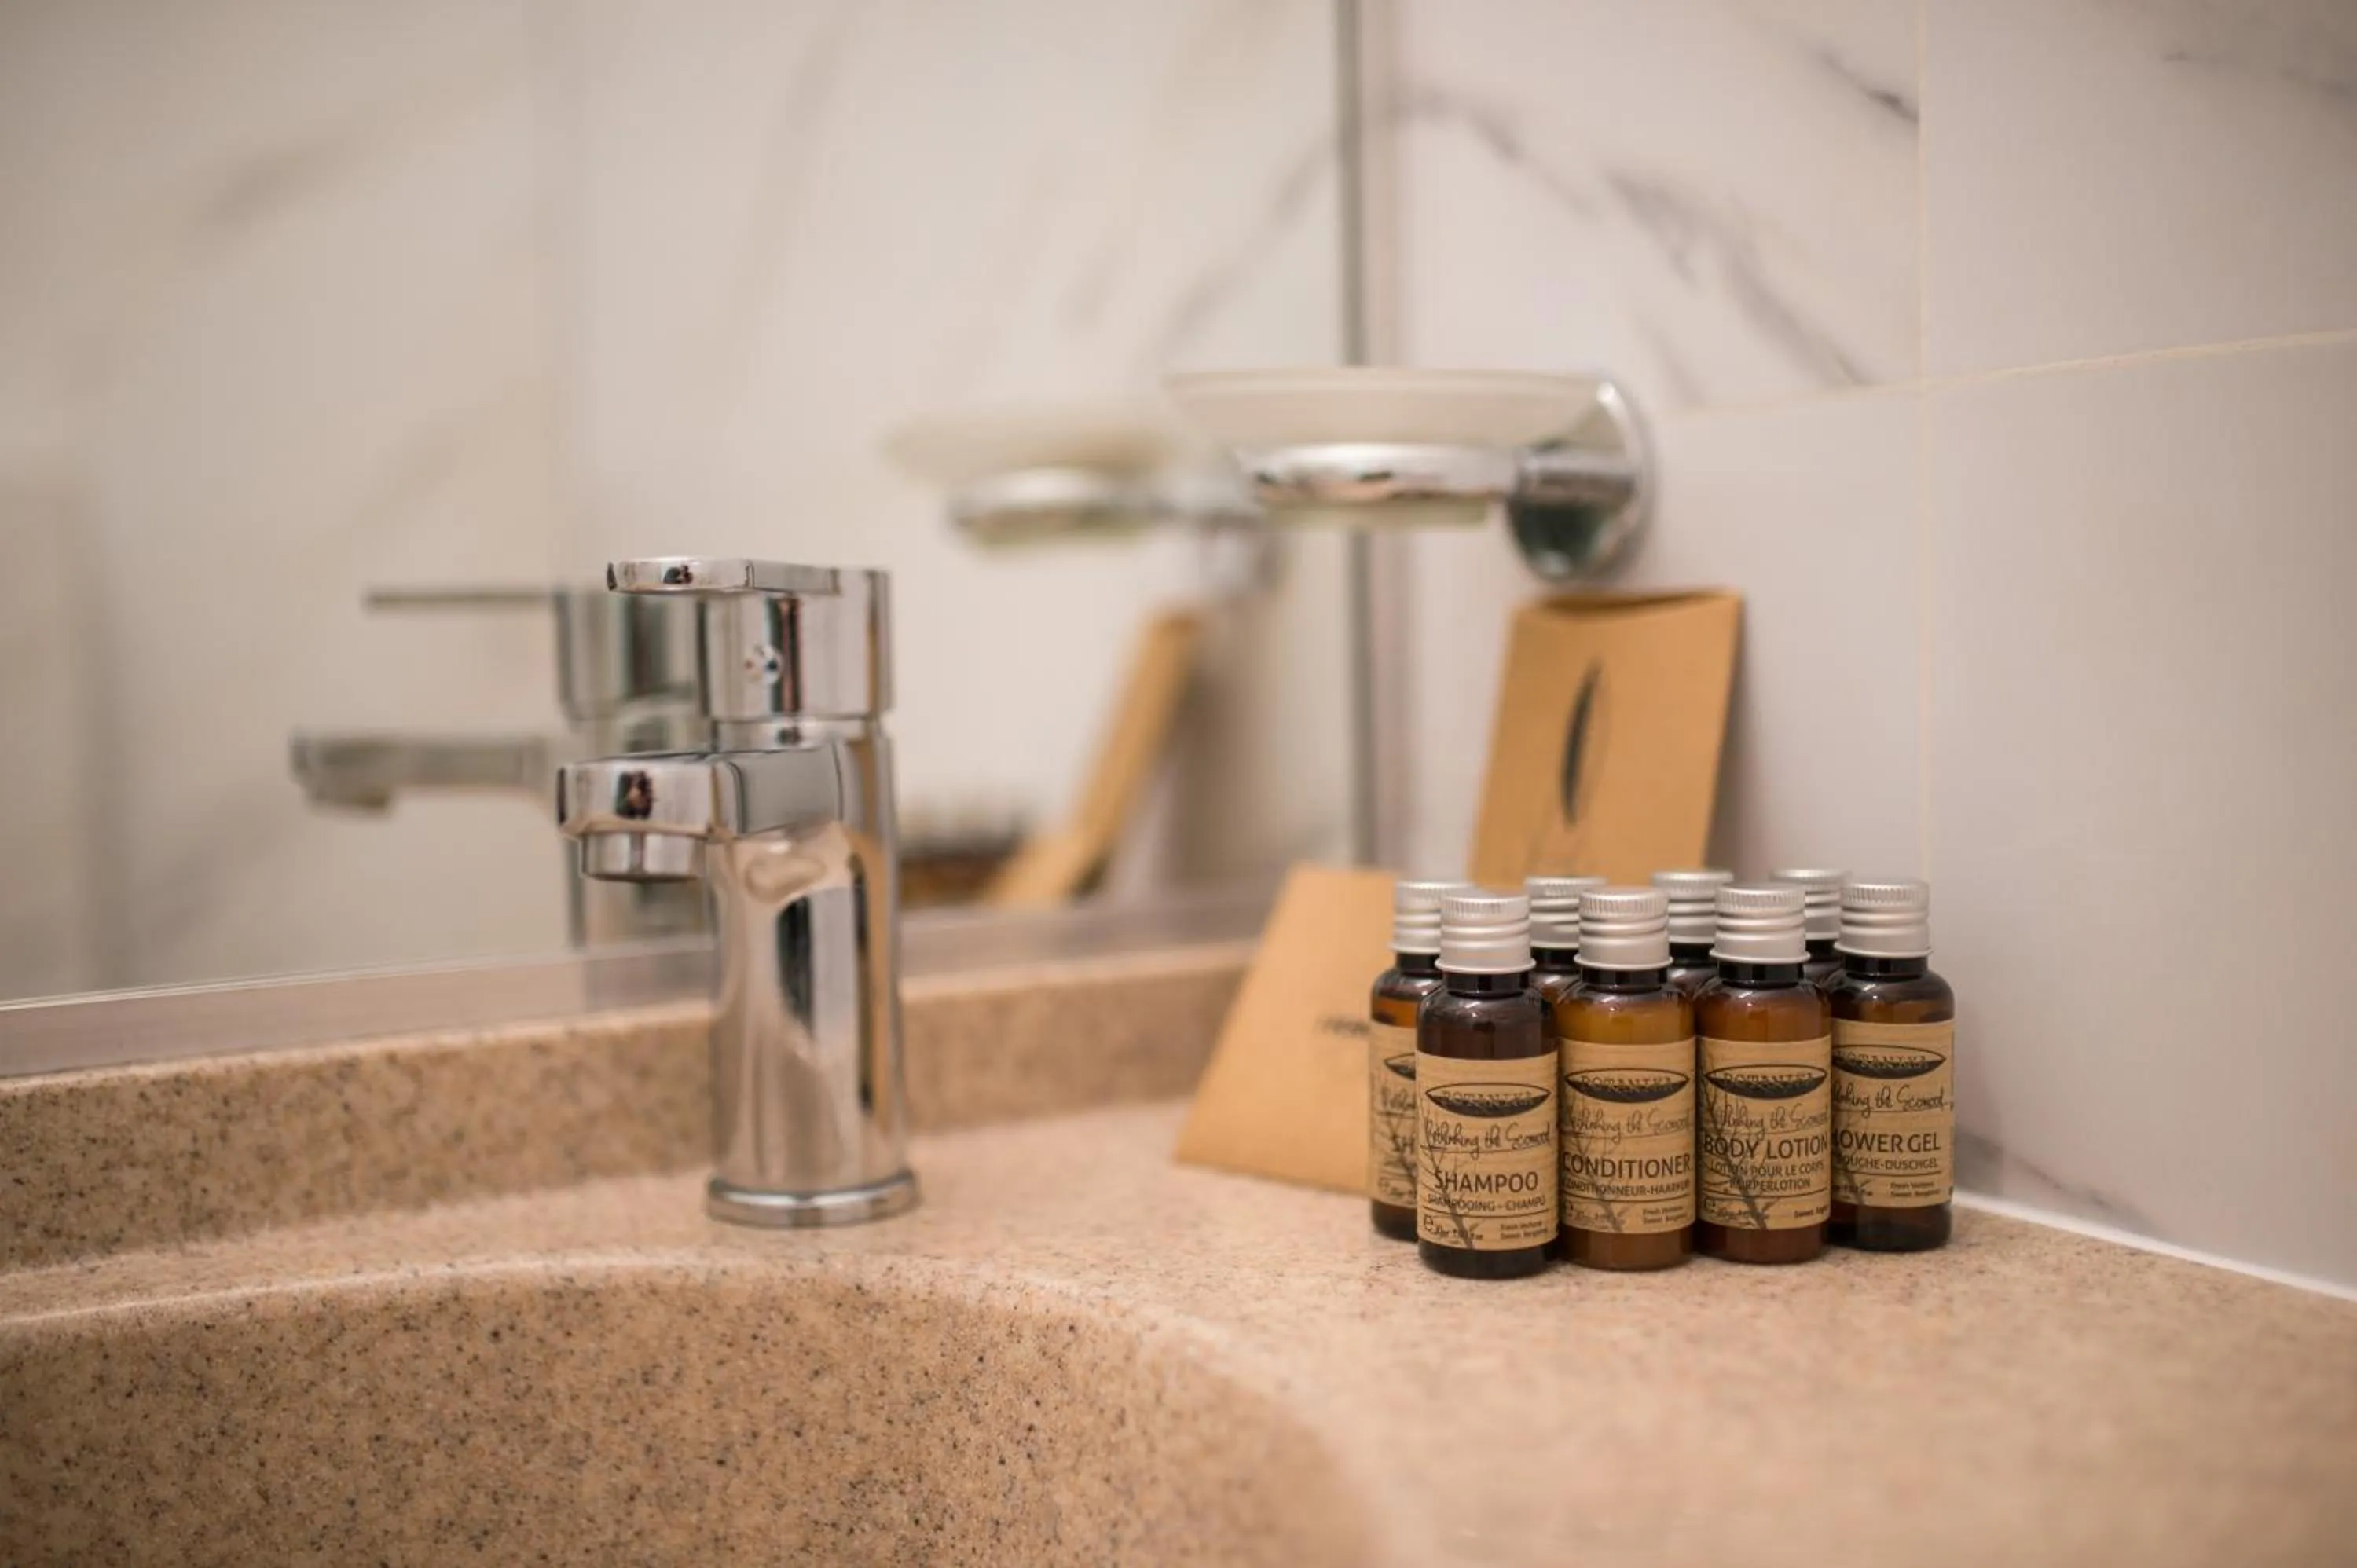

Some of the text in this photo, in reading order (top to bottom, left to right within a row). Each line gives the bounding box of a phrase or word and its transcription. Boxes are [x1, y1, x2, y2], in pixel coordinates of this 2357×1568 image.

[1485, 1125, 1501, 1149] the
[1703, 1133, 1828, 1160] BODY LOTION
[1831, 1128, 1941, 1153] HOWER GEL
[1563, 1152, 1692, 1179] CONDITIONER
[1751, 1164, 1782, 1178] POUR
[1785, 1164, 1797, 1176] LE
[1434, 1170, 1538, 1194] SHAMPOO
